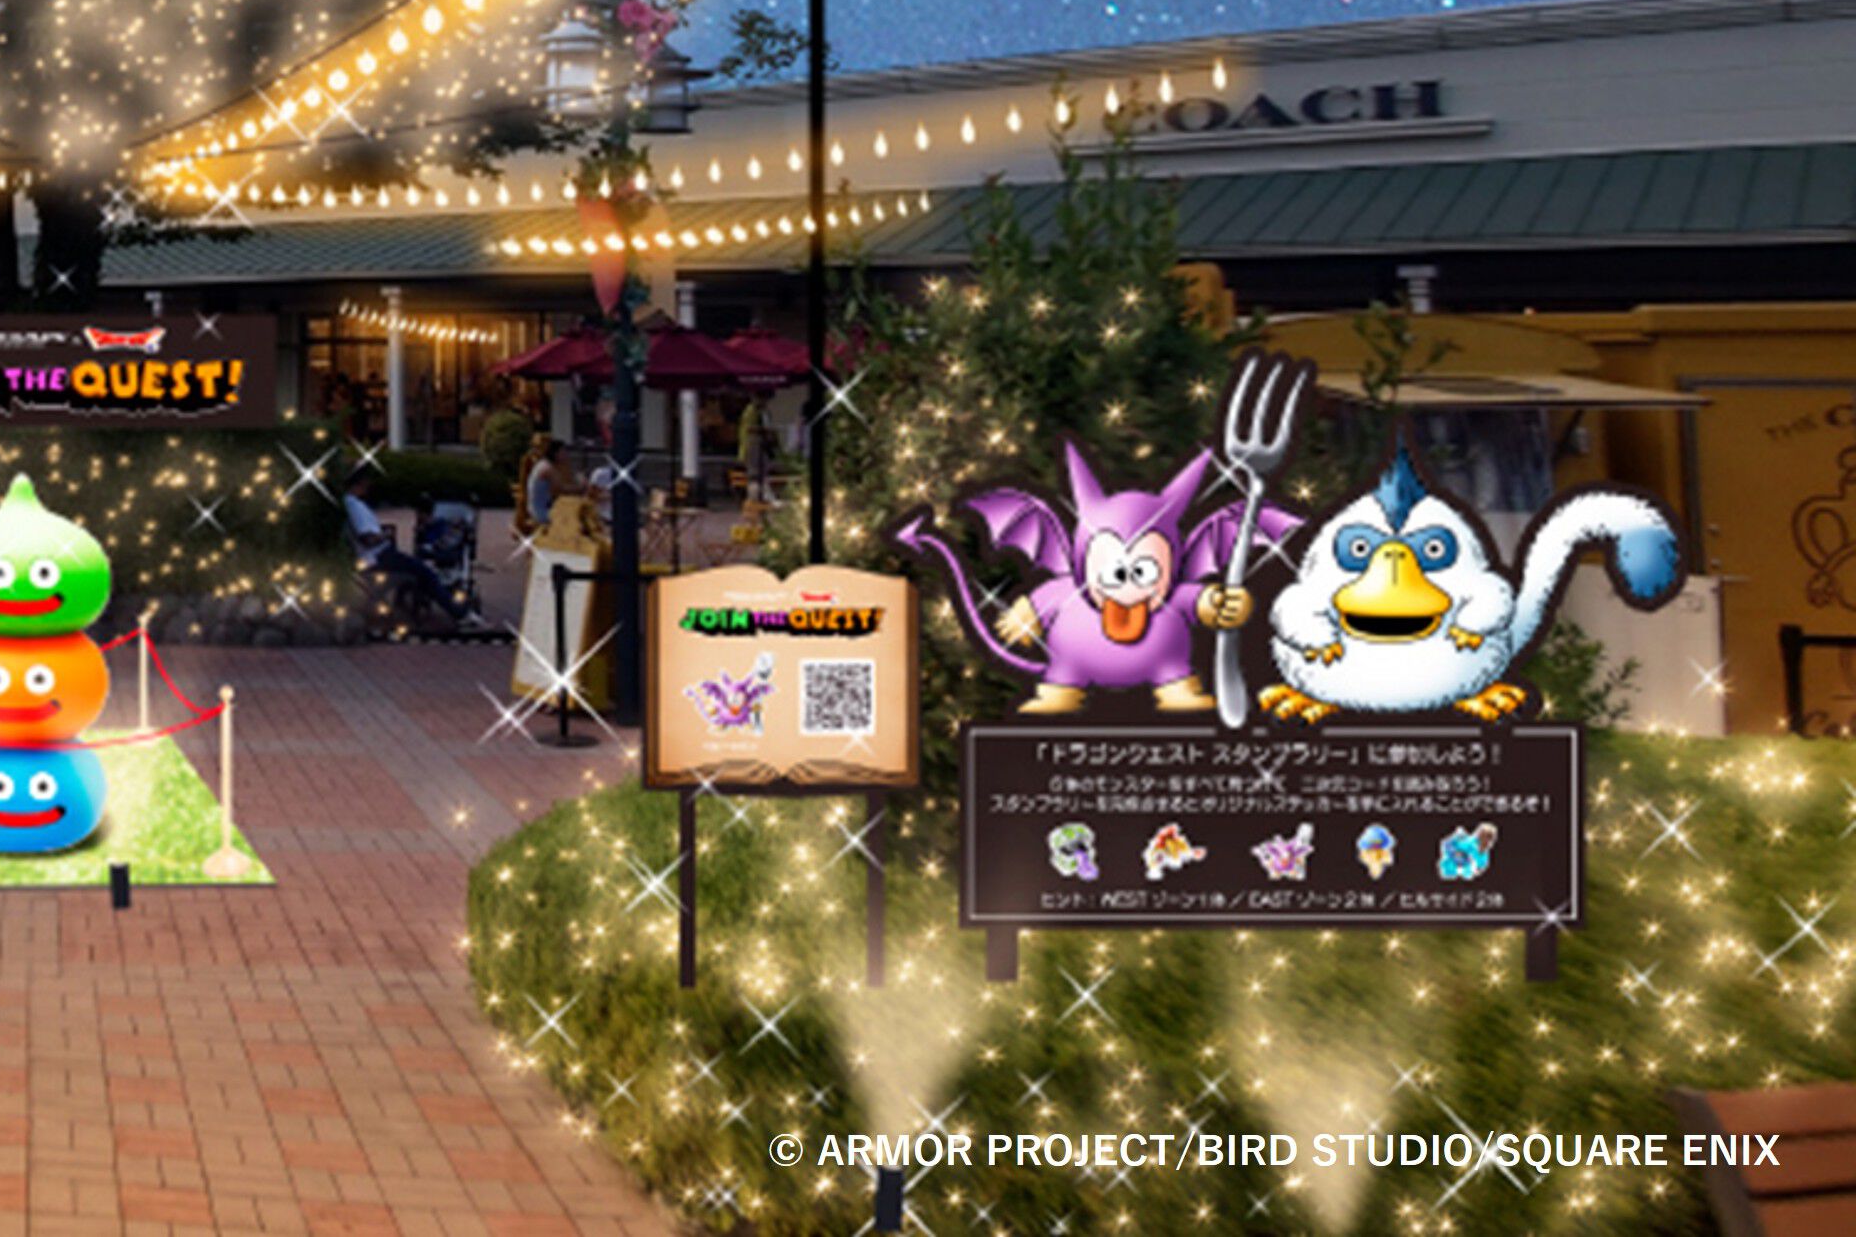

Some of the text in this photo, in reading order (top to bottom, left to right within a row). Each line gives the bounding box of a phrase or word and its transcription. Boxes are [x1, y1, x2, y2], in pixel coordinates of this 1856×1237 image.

[4, 366, 66, 391] THE
[71, 359, 243, 403] QUEST!
[679, 607, 749, 630] JOIN
[789, 607, 885, 632] QUEST!
